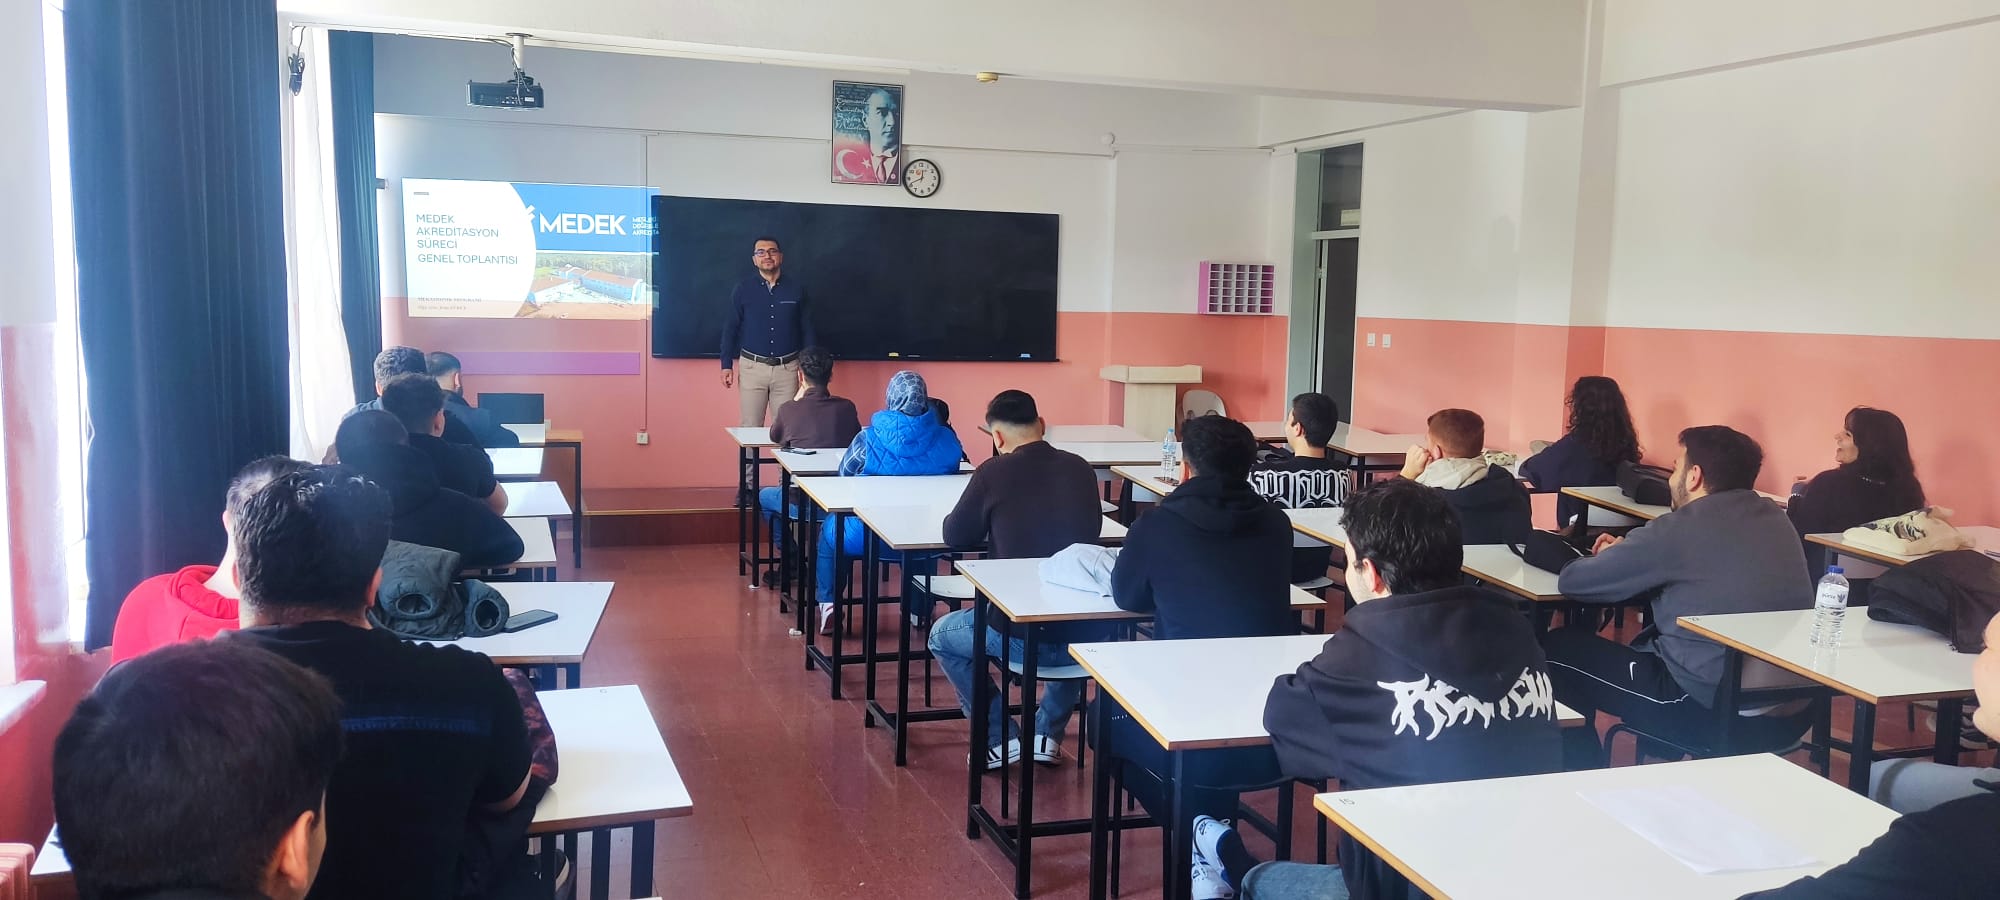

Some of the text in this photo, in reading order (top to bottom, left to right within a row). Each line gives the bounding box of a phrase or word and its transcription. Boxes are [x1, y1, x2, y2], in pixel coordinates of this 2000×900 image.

[416, 214, 455, 224] MEDEK
[539, 212, 627, 236] MEDEK
[416, 226, 499, 238] AKREDİTASYON
[417, 237, 458, 249] SÜRECİ
[417, 253, 518, 265] GENEL TOPLANTISI
